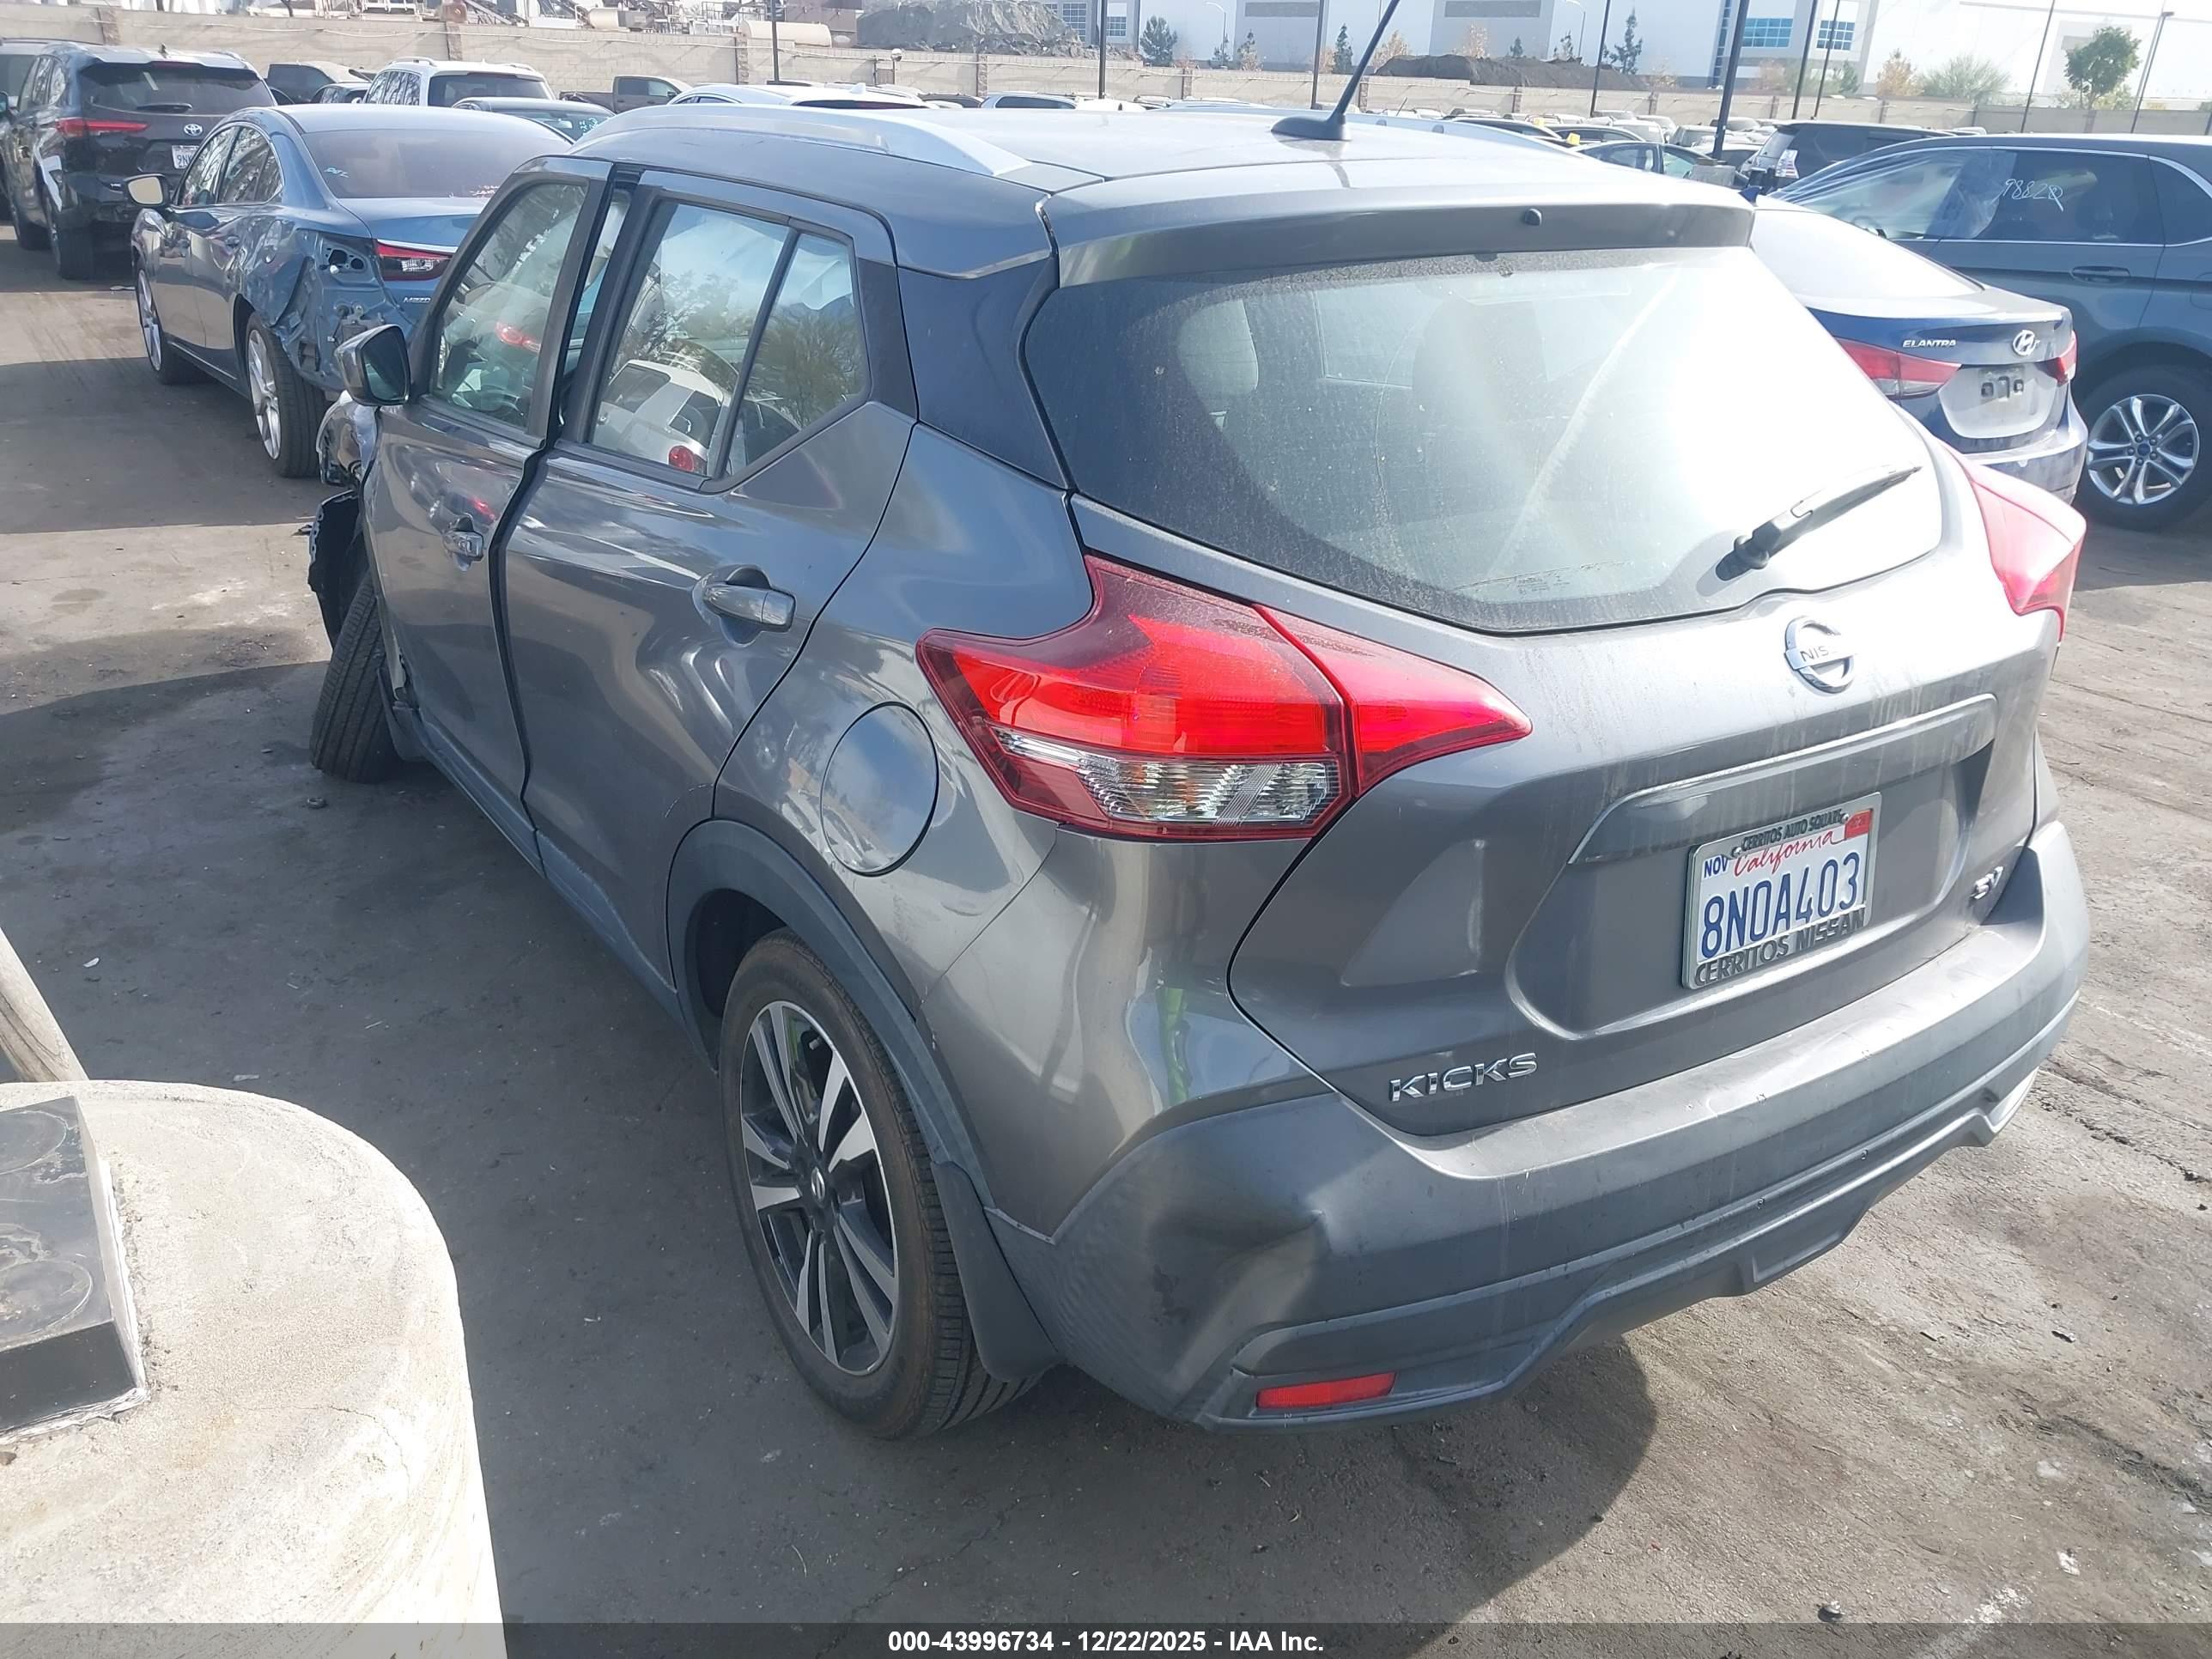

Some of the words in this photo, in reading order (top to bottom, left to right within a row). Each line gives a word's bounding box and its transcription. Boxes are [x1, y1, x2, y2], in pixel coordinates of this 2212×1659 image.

[1902, 339, 1957, 348] ELANTRA
[1734, 830, 1845, 877] California
[1741, 826, 1783, 852] CERRITOS
[1783, 818, 1808, 840] AUTO
[1704, 855, 1729, 878] NOV
[1694, 935, 1790, 987] CERRITOS
[1796, 908, 1866, 951] NISSAN
[1389, 1053, 1538, 1102] KICKS
